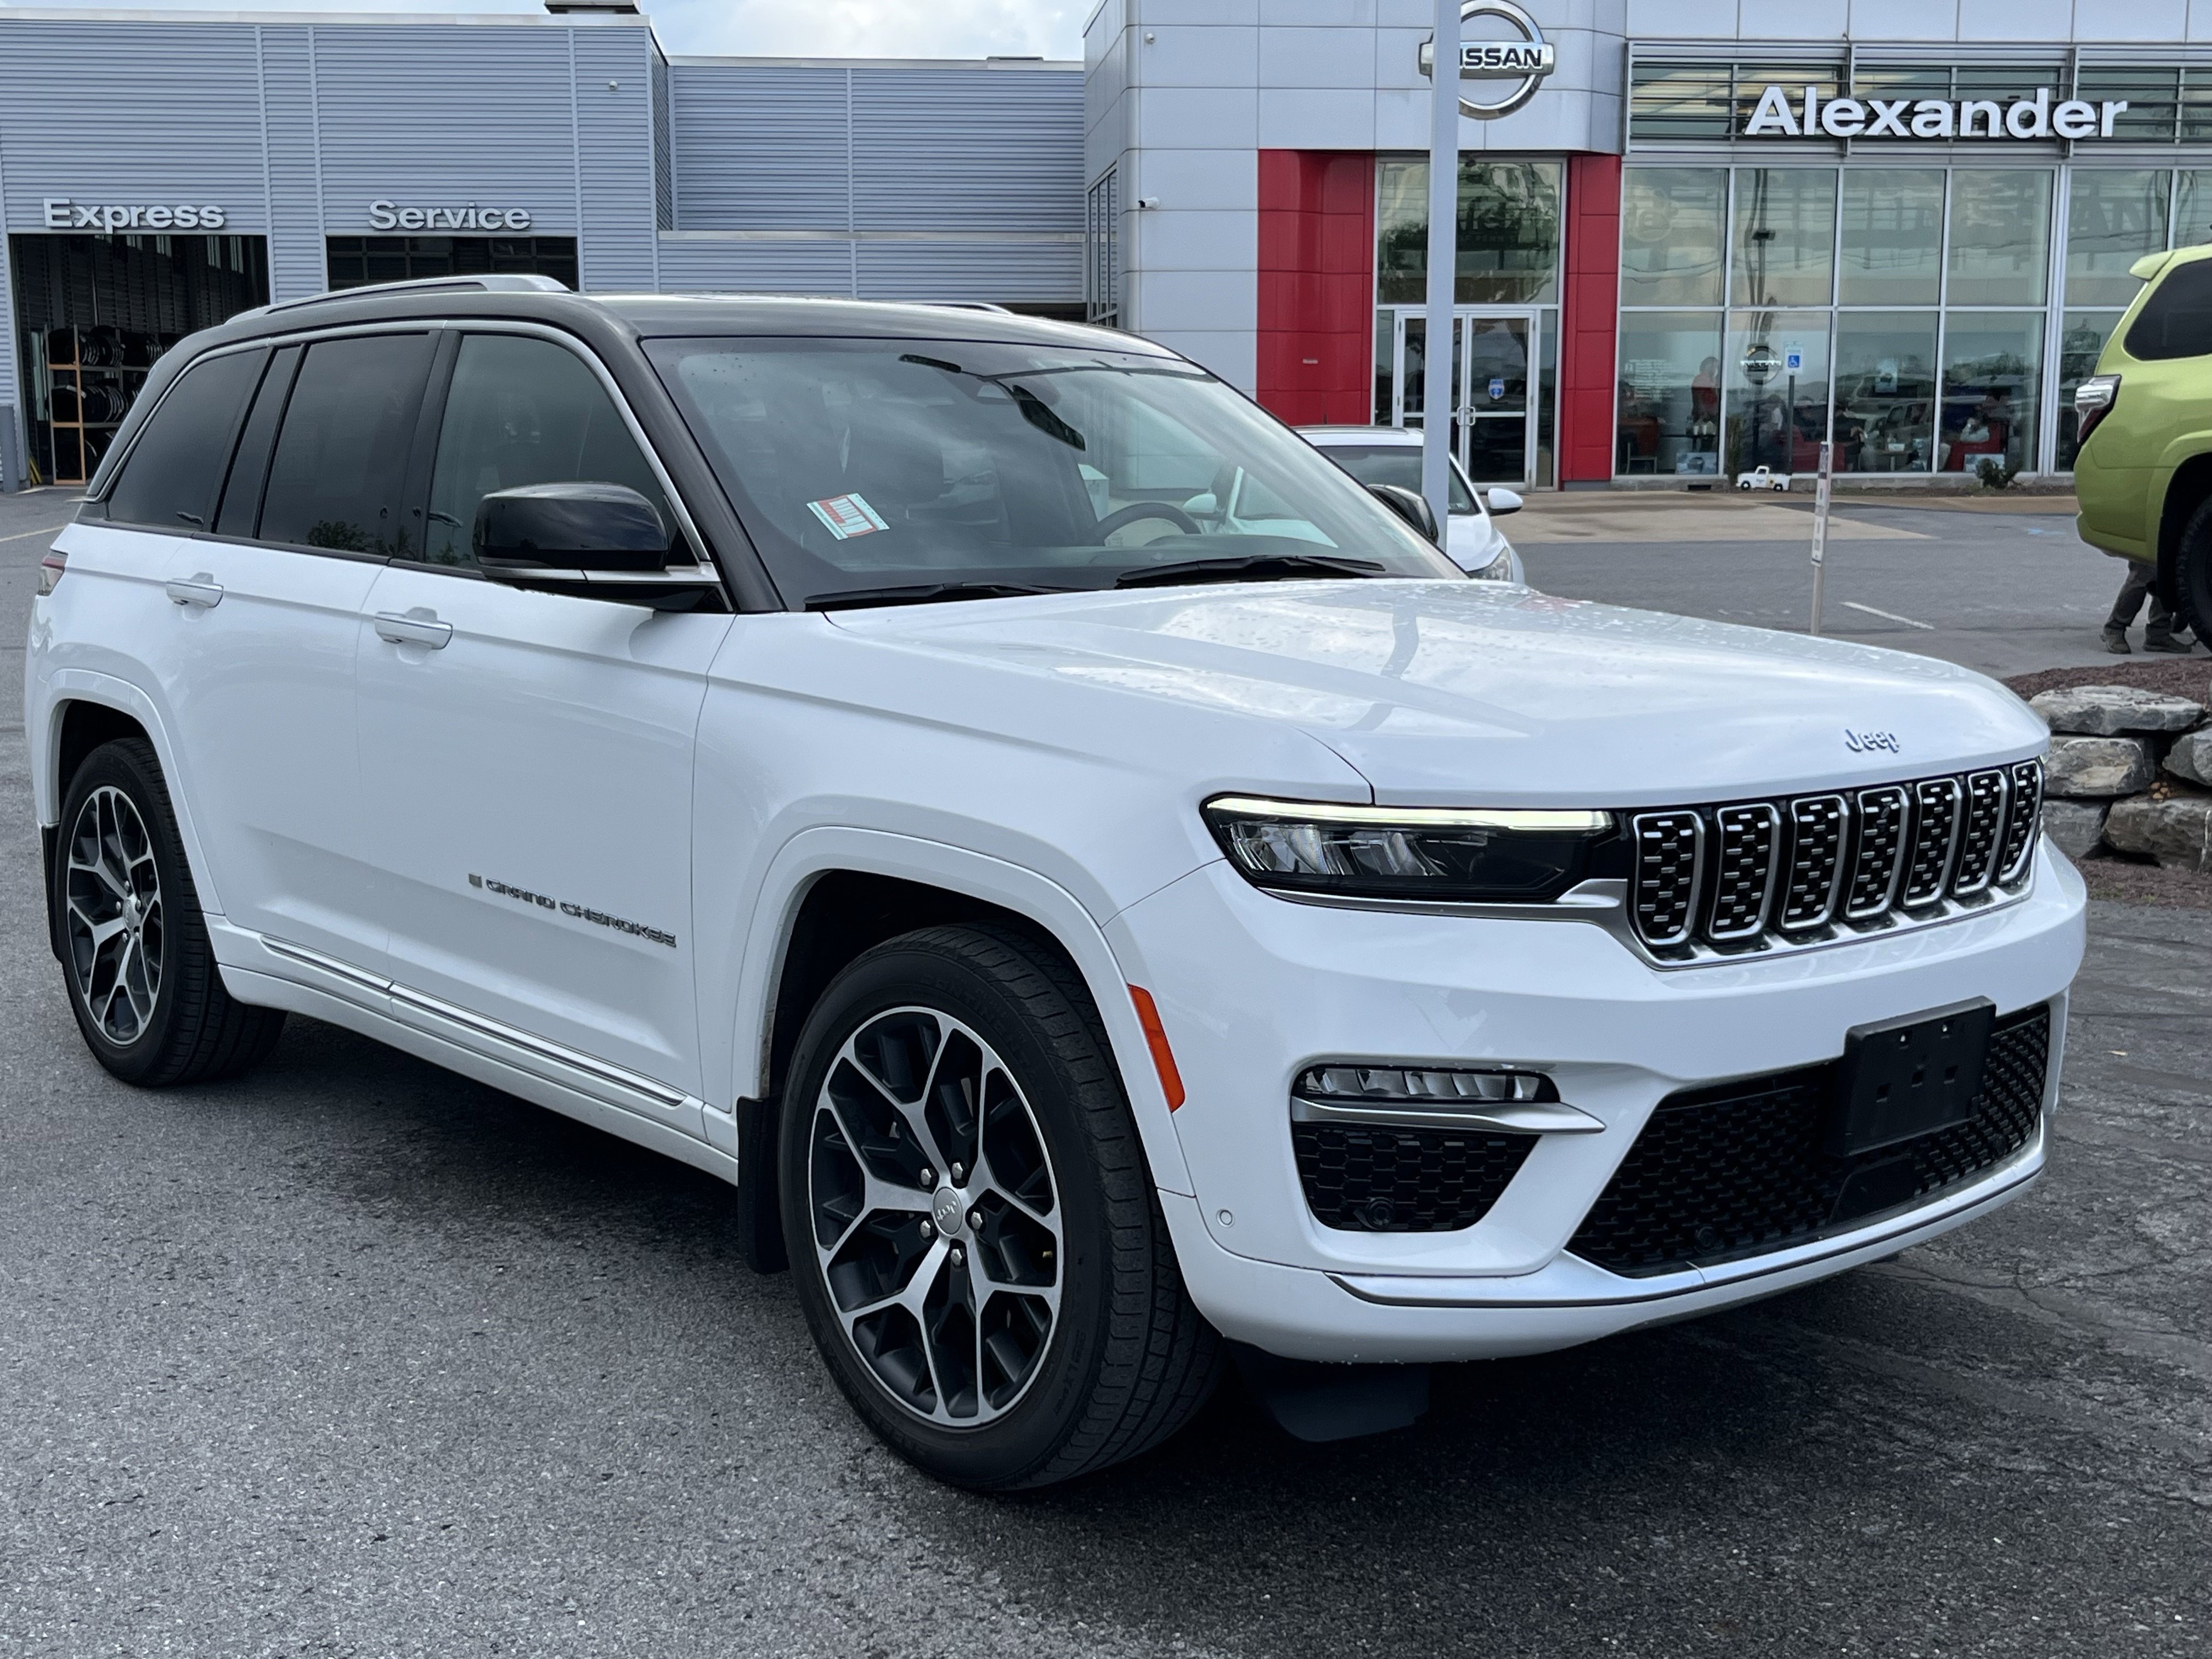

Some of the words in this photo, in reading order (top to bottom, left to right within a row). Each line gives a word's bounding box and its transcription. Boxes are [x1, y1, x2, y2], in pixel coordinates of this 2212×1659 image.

[1460, 48, 1542, 66] ISSAN
[1744, 86, 2128, 138] Alexander
[43, 198, 224, 234] Express
[369, 200, 531, 229] Service
[1845, 729, 1900, 754] Jeep
[486, 878, 556, 910] GRAND
[560, 900, 676, 947] CHEROKEE
